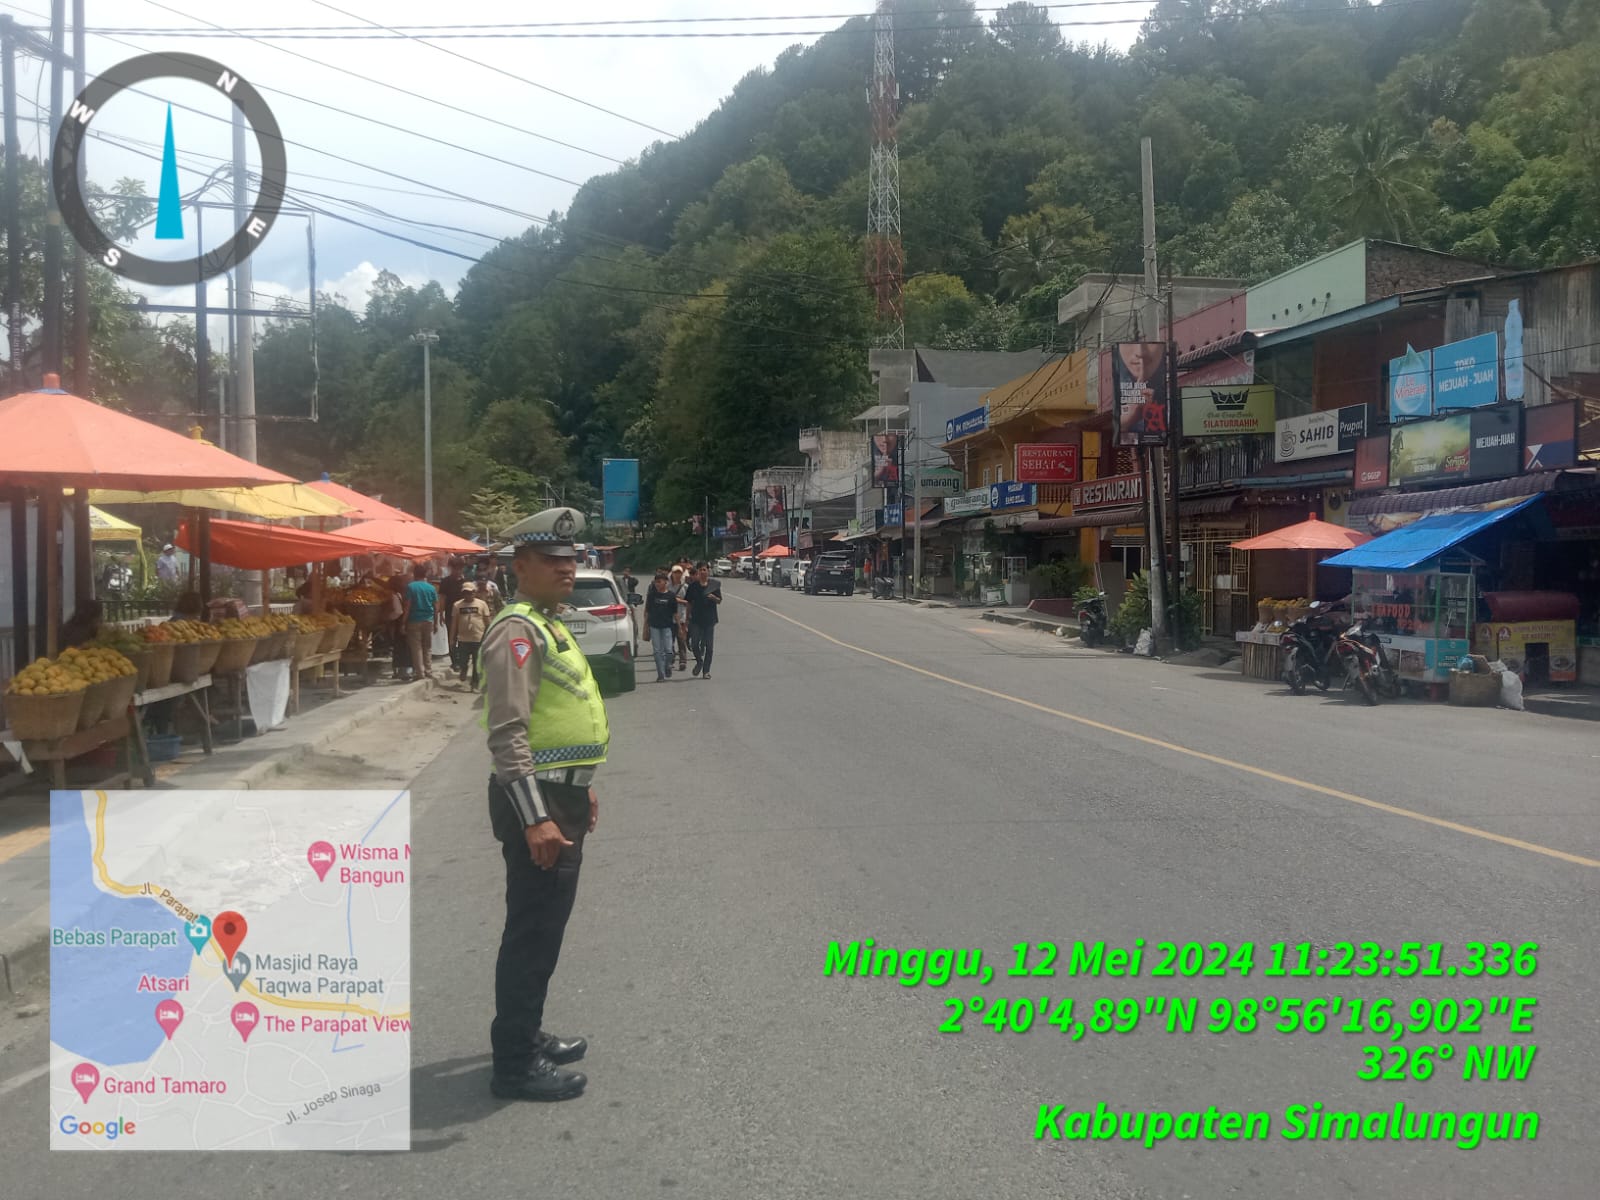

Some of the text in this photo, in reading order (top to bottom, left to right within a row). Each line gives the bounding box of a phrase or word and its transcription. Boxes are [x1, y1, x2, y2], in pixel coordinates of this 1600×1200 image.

[1454, 357, 1476, 372] TOKO
[1438, 376, 1469, 392] MEJUAH
[1473, 370, 1494, 385] JUAH
[1203, 419, 1259, 429] SILATURRAHIM
[1299, 425, 1335, 444] SAHIB
[1022, 449, 1074, 458] RESTAURANT
[1022, 458, 1056, 470] SEHAT
